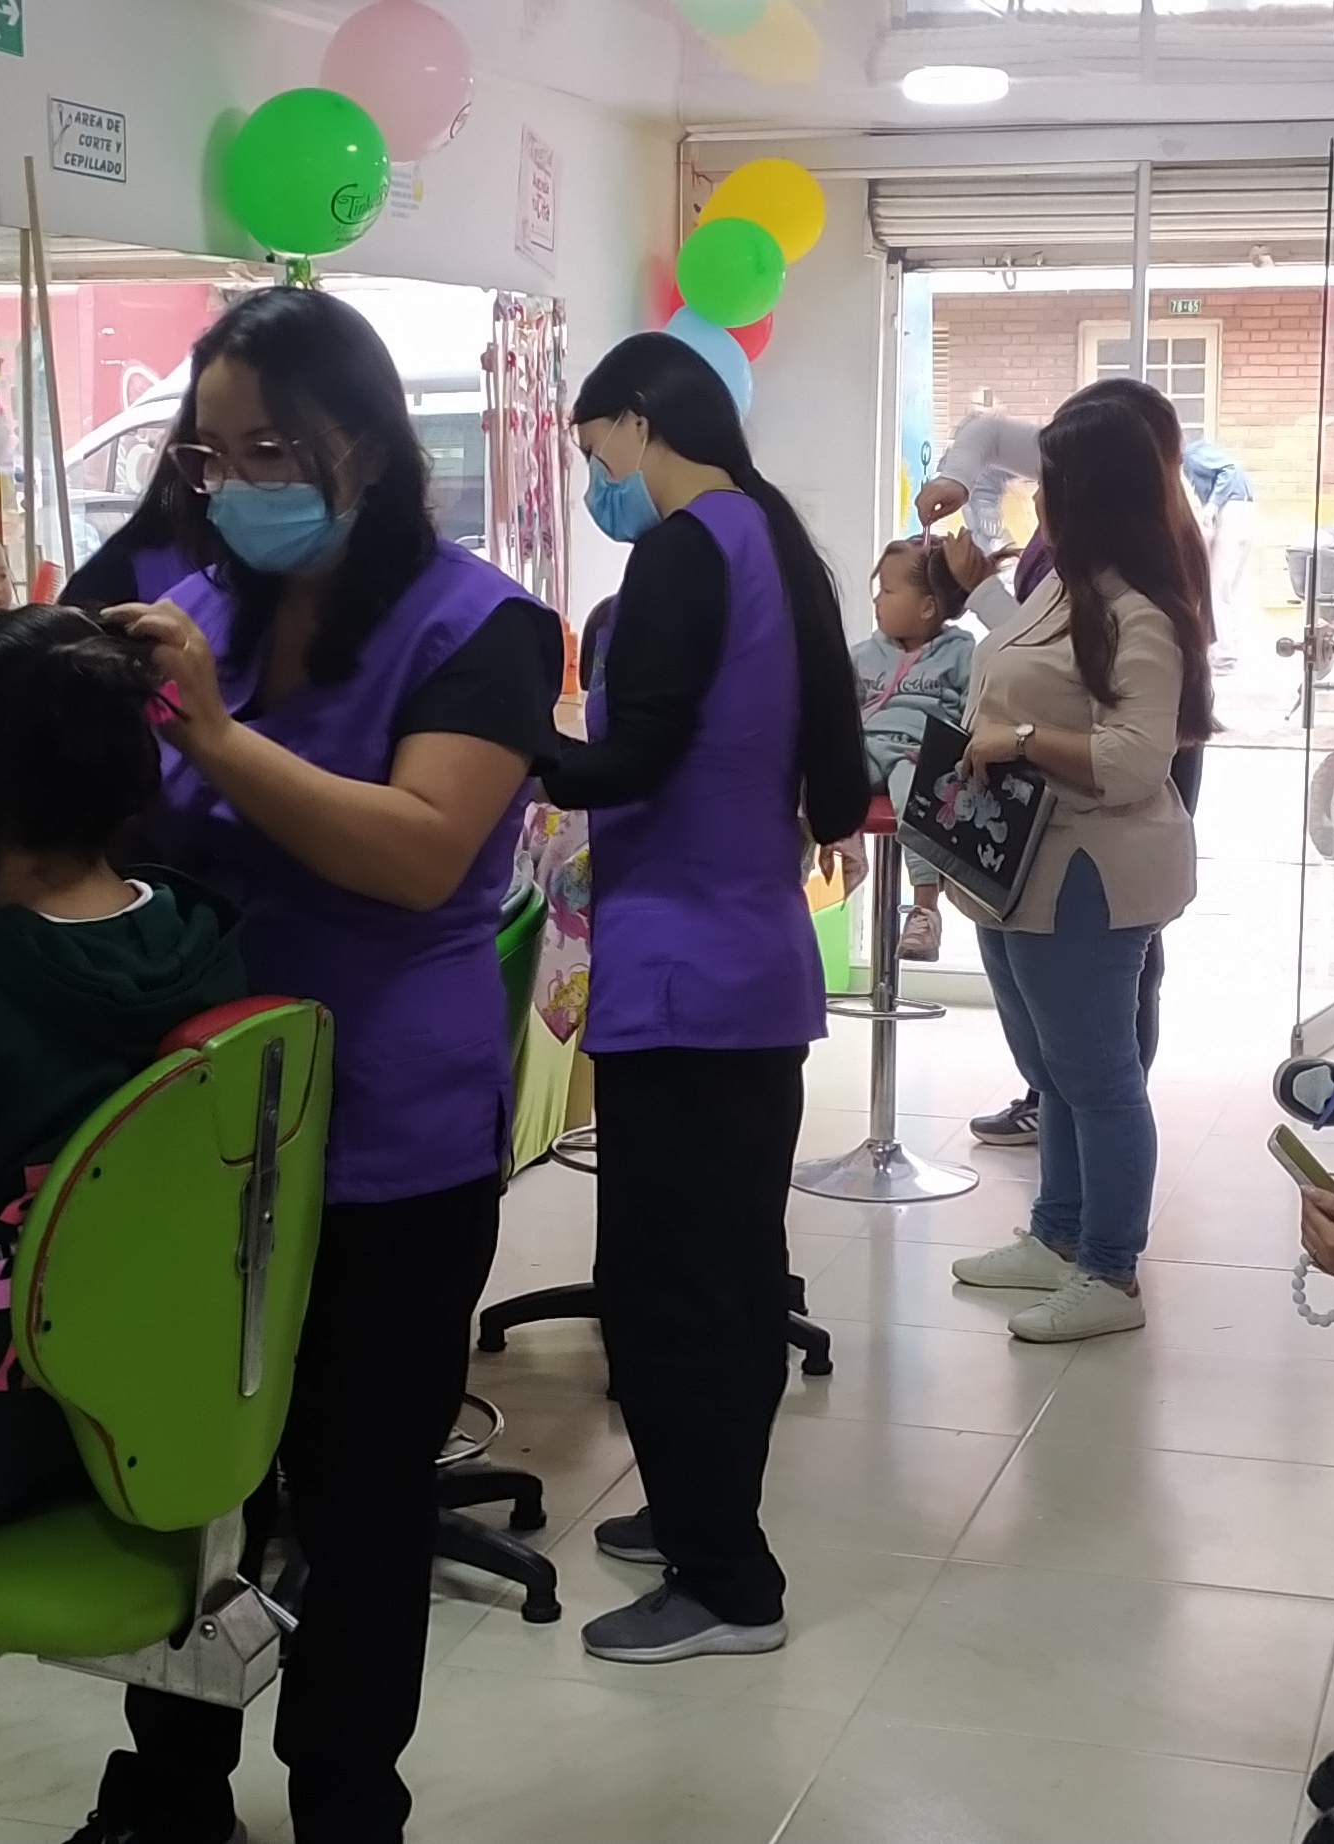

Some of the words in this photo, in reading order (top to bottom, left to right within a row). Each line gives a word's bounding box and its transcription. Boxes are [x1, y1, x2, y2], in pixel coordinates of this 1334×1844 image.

[74, 111, 103, 128] AREA
[106, 117, 121, 133] DE
[78, 133, 112, 152] CORTE
[116, 141, 122, 153] Y
[63, 151, 122, 175] CEPILLADO
